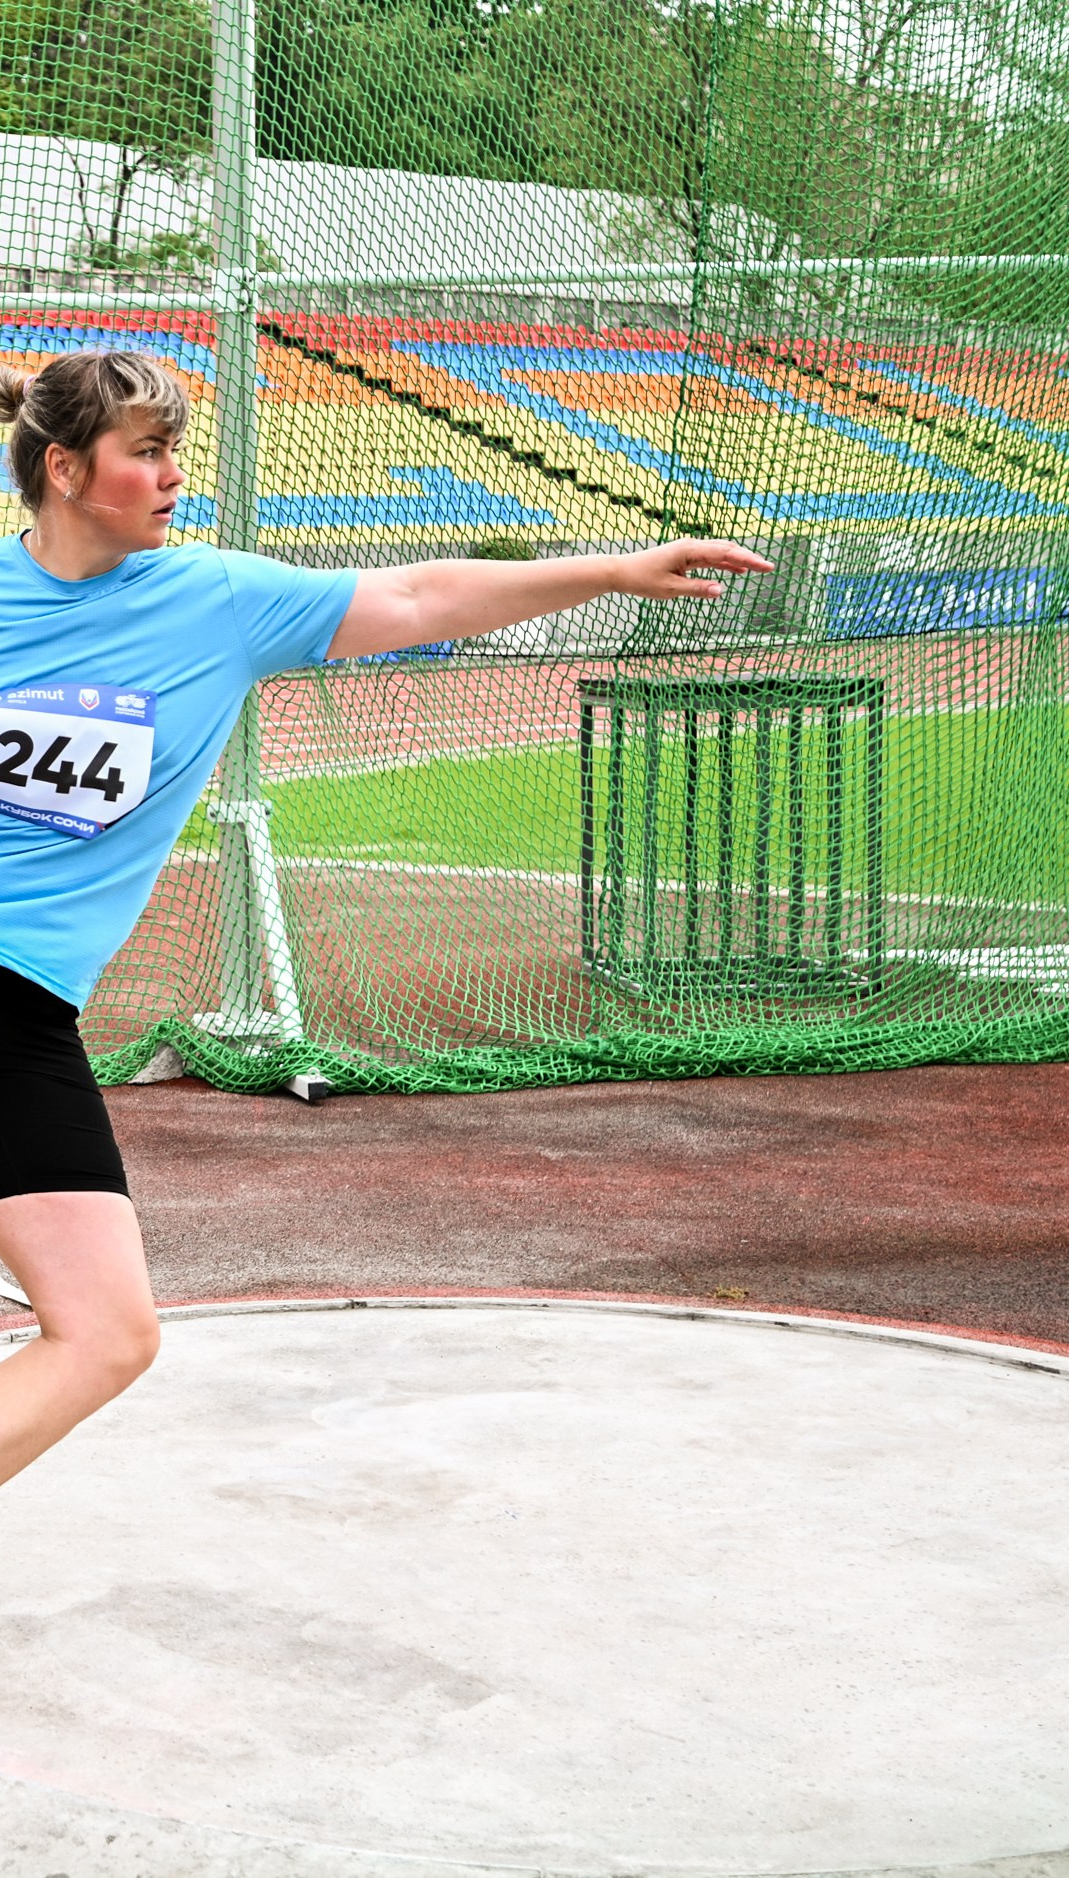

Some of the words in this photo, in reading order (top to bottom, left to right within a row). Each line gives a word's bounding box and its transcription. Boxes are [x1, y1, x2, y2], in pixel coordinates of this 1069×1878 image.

[7, 688, 65, 701] azimut
[0, 802, 53, 823] КУБОК
[53, 815, 95, 834] СОЧИ
